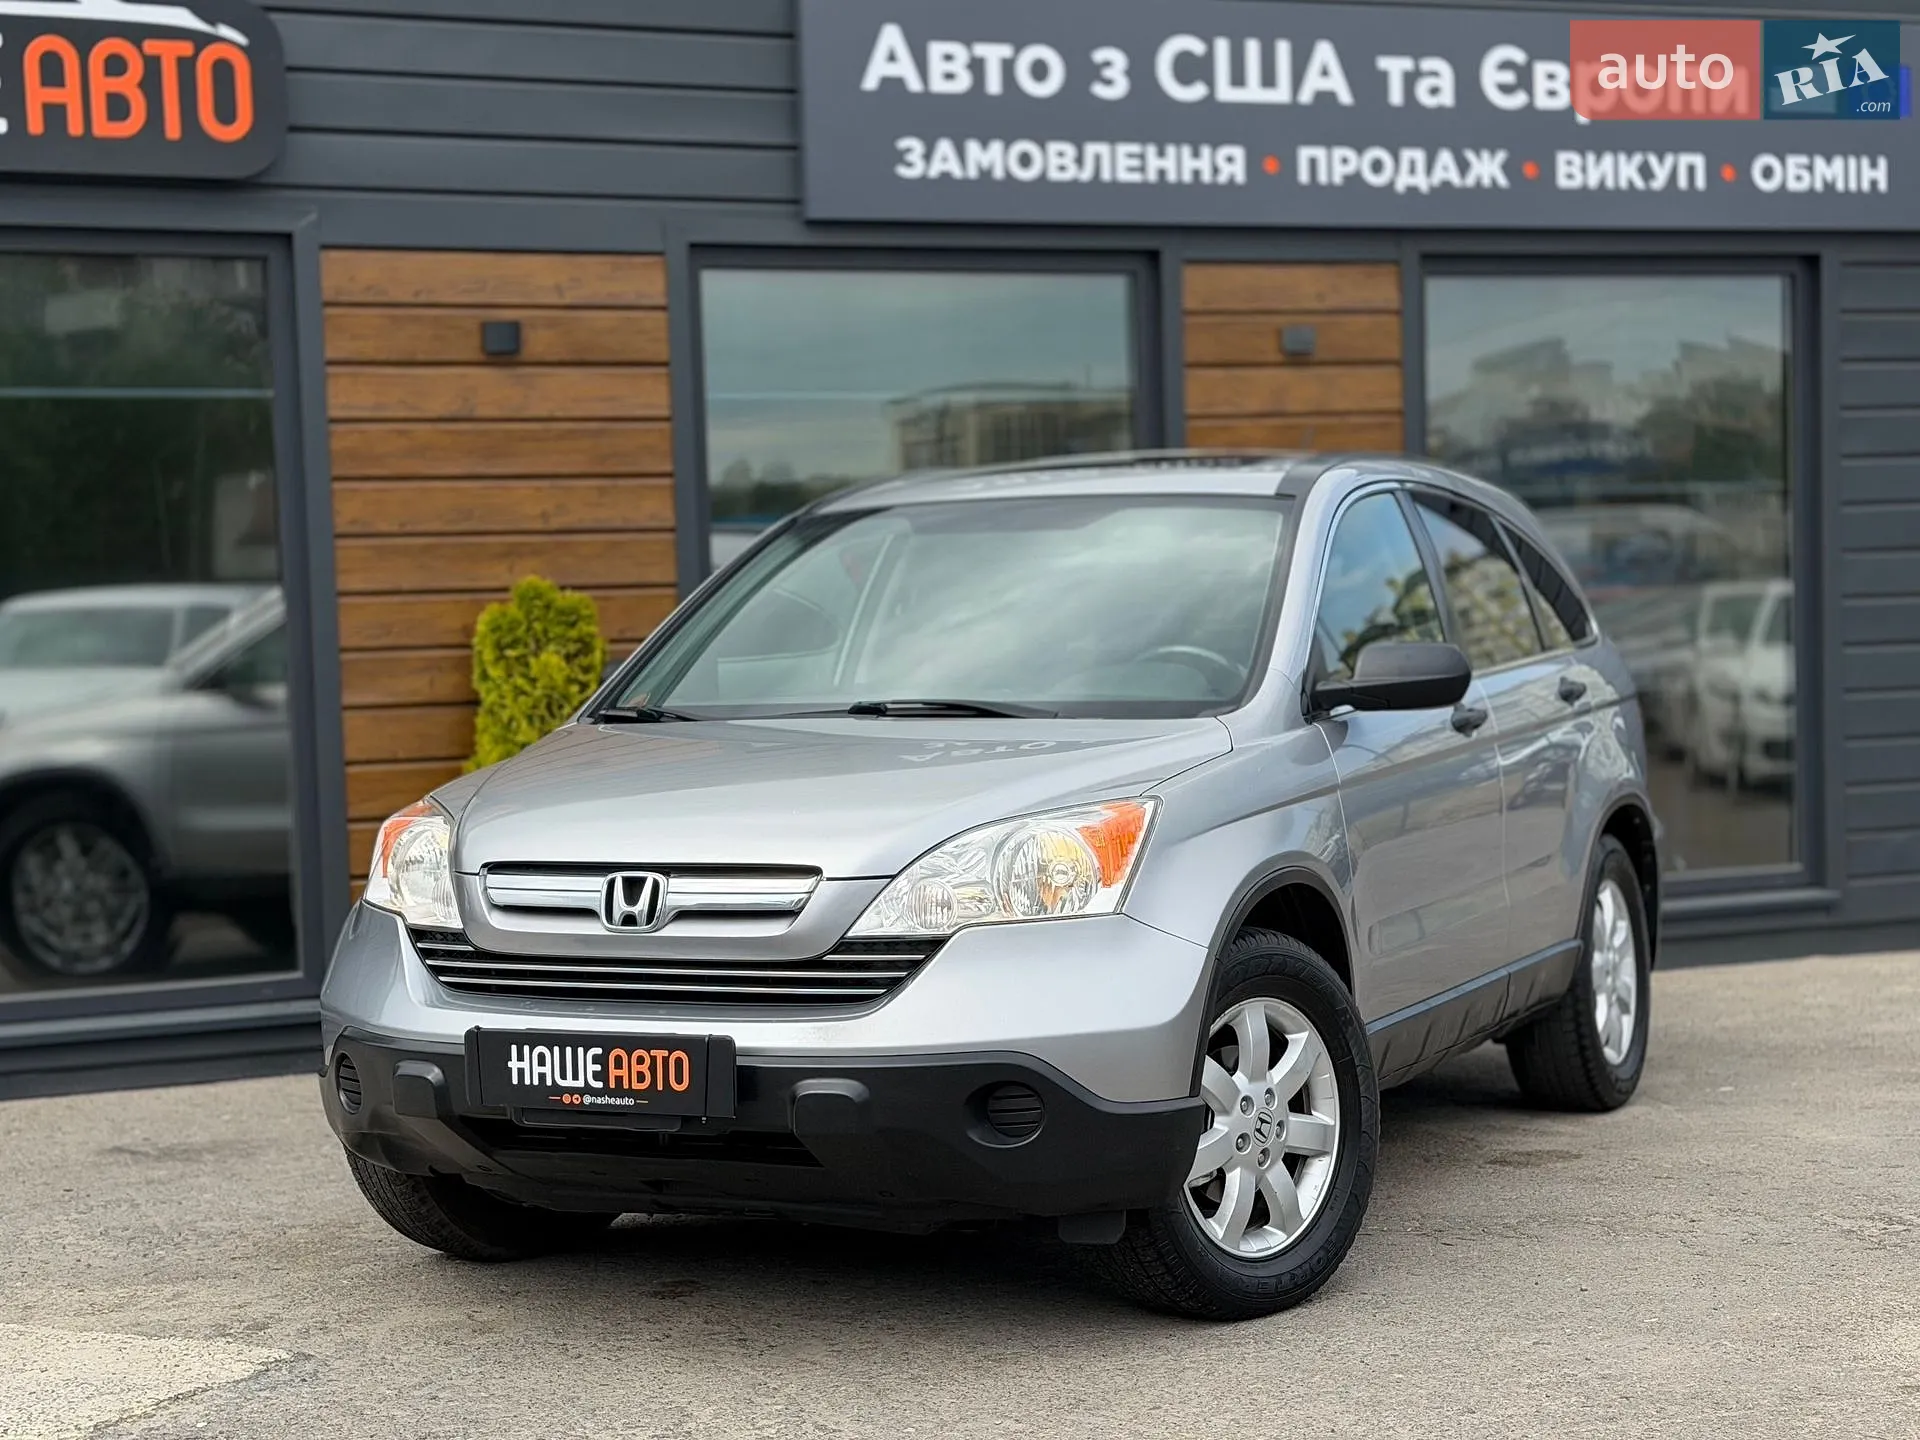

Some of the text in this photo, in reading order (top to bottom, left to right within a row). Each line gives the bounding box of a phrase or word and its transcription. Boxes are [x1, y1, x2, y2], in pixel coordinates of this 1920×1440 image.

[24, 35, 253, 142] АВТО
[861, 23, 1065, 98] Авто
[1091, 47, 1130, 100] з
[1156, 34, 1354, 105] США
[1377, 57, 1455, 107] та
[896, 137, 1888, 194] ЗАМОВЛЕННЯ ПРОДАЖ ВИКУП ОБМІН
[508, 1045, 690, 1092] НАШЕ АВТО
[583, 1094, 634, 1106] @nasheauto
